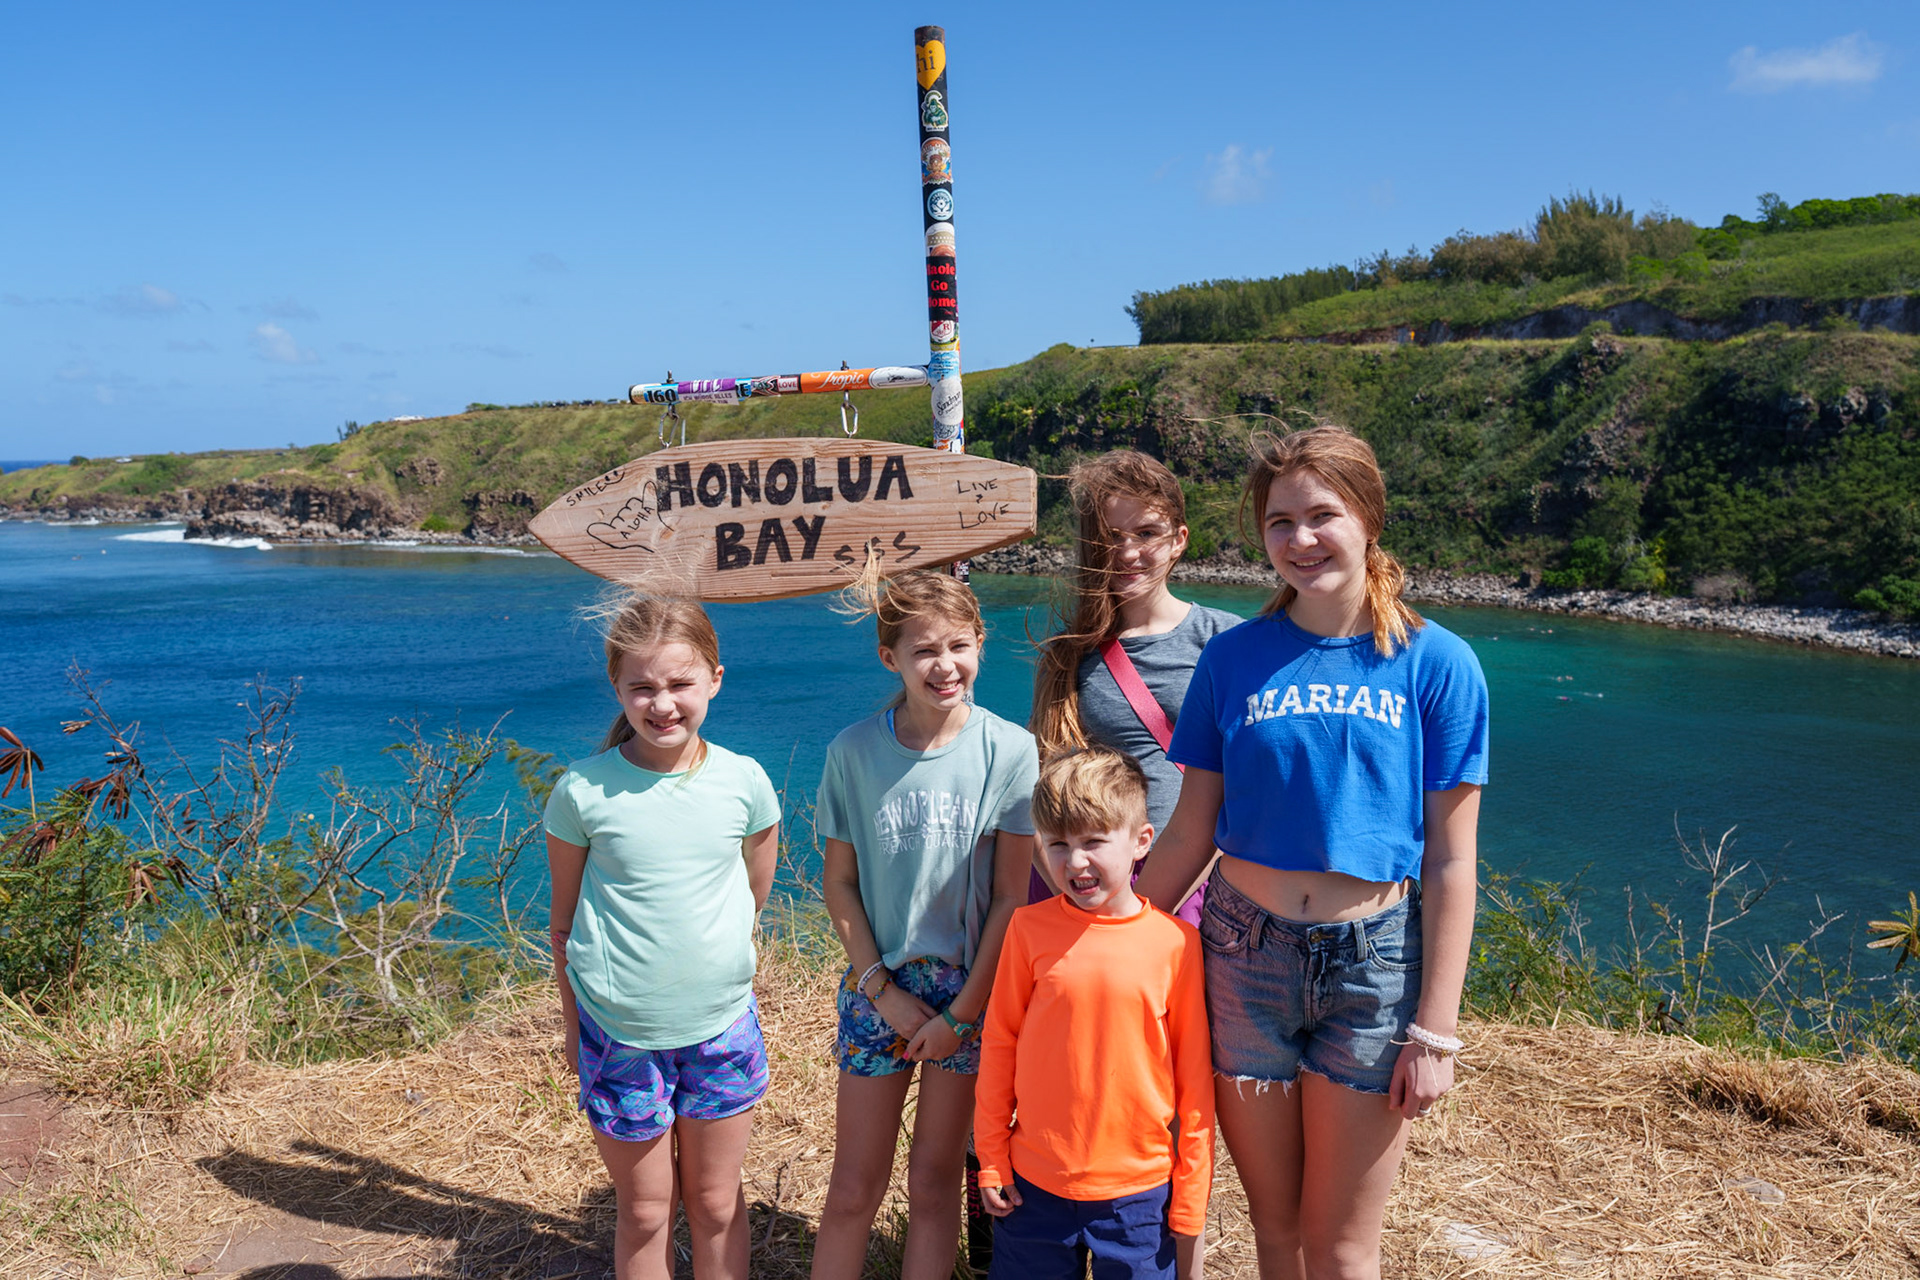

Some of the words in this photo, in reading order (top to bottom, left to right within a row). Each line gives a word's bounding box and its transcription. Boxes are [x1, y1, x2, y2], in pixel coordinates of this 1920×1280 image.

[916, 50, 935, 73] hi
[930, 279, 948, 291] Go
[778, 381, 797, 389] LOVE
[811, 370, 865, 390] Tropic
[646, 388, 677, 403] 160
[566, 479, 608, 507] SMILE
[655, 455, 914, 512] HONOLUA
[957, 478, 999, 494] LIVE
[620, 505, 655, 540] ALOHA
[958, 502, 1010, 529] LOVE
[715, 515, 826, 571] BAY
[1244, 683, 1407, 729] MARIAN
[873, 796, 903, 837] NEW
[905, 789, 977, 829] ORLEAN
[880, 834, 921, 855] RENCH
[925, 833, 972, 850] QUART
